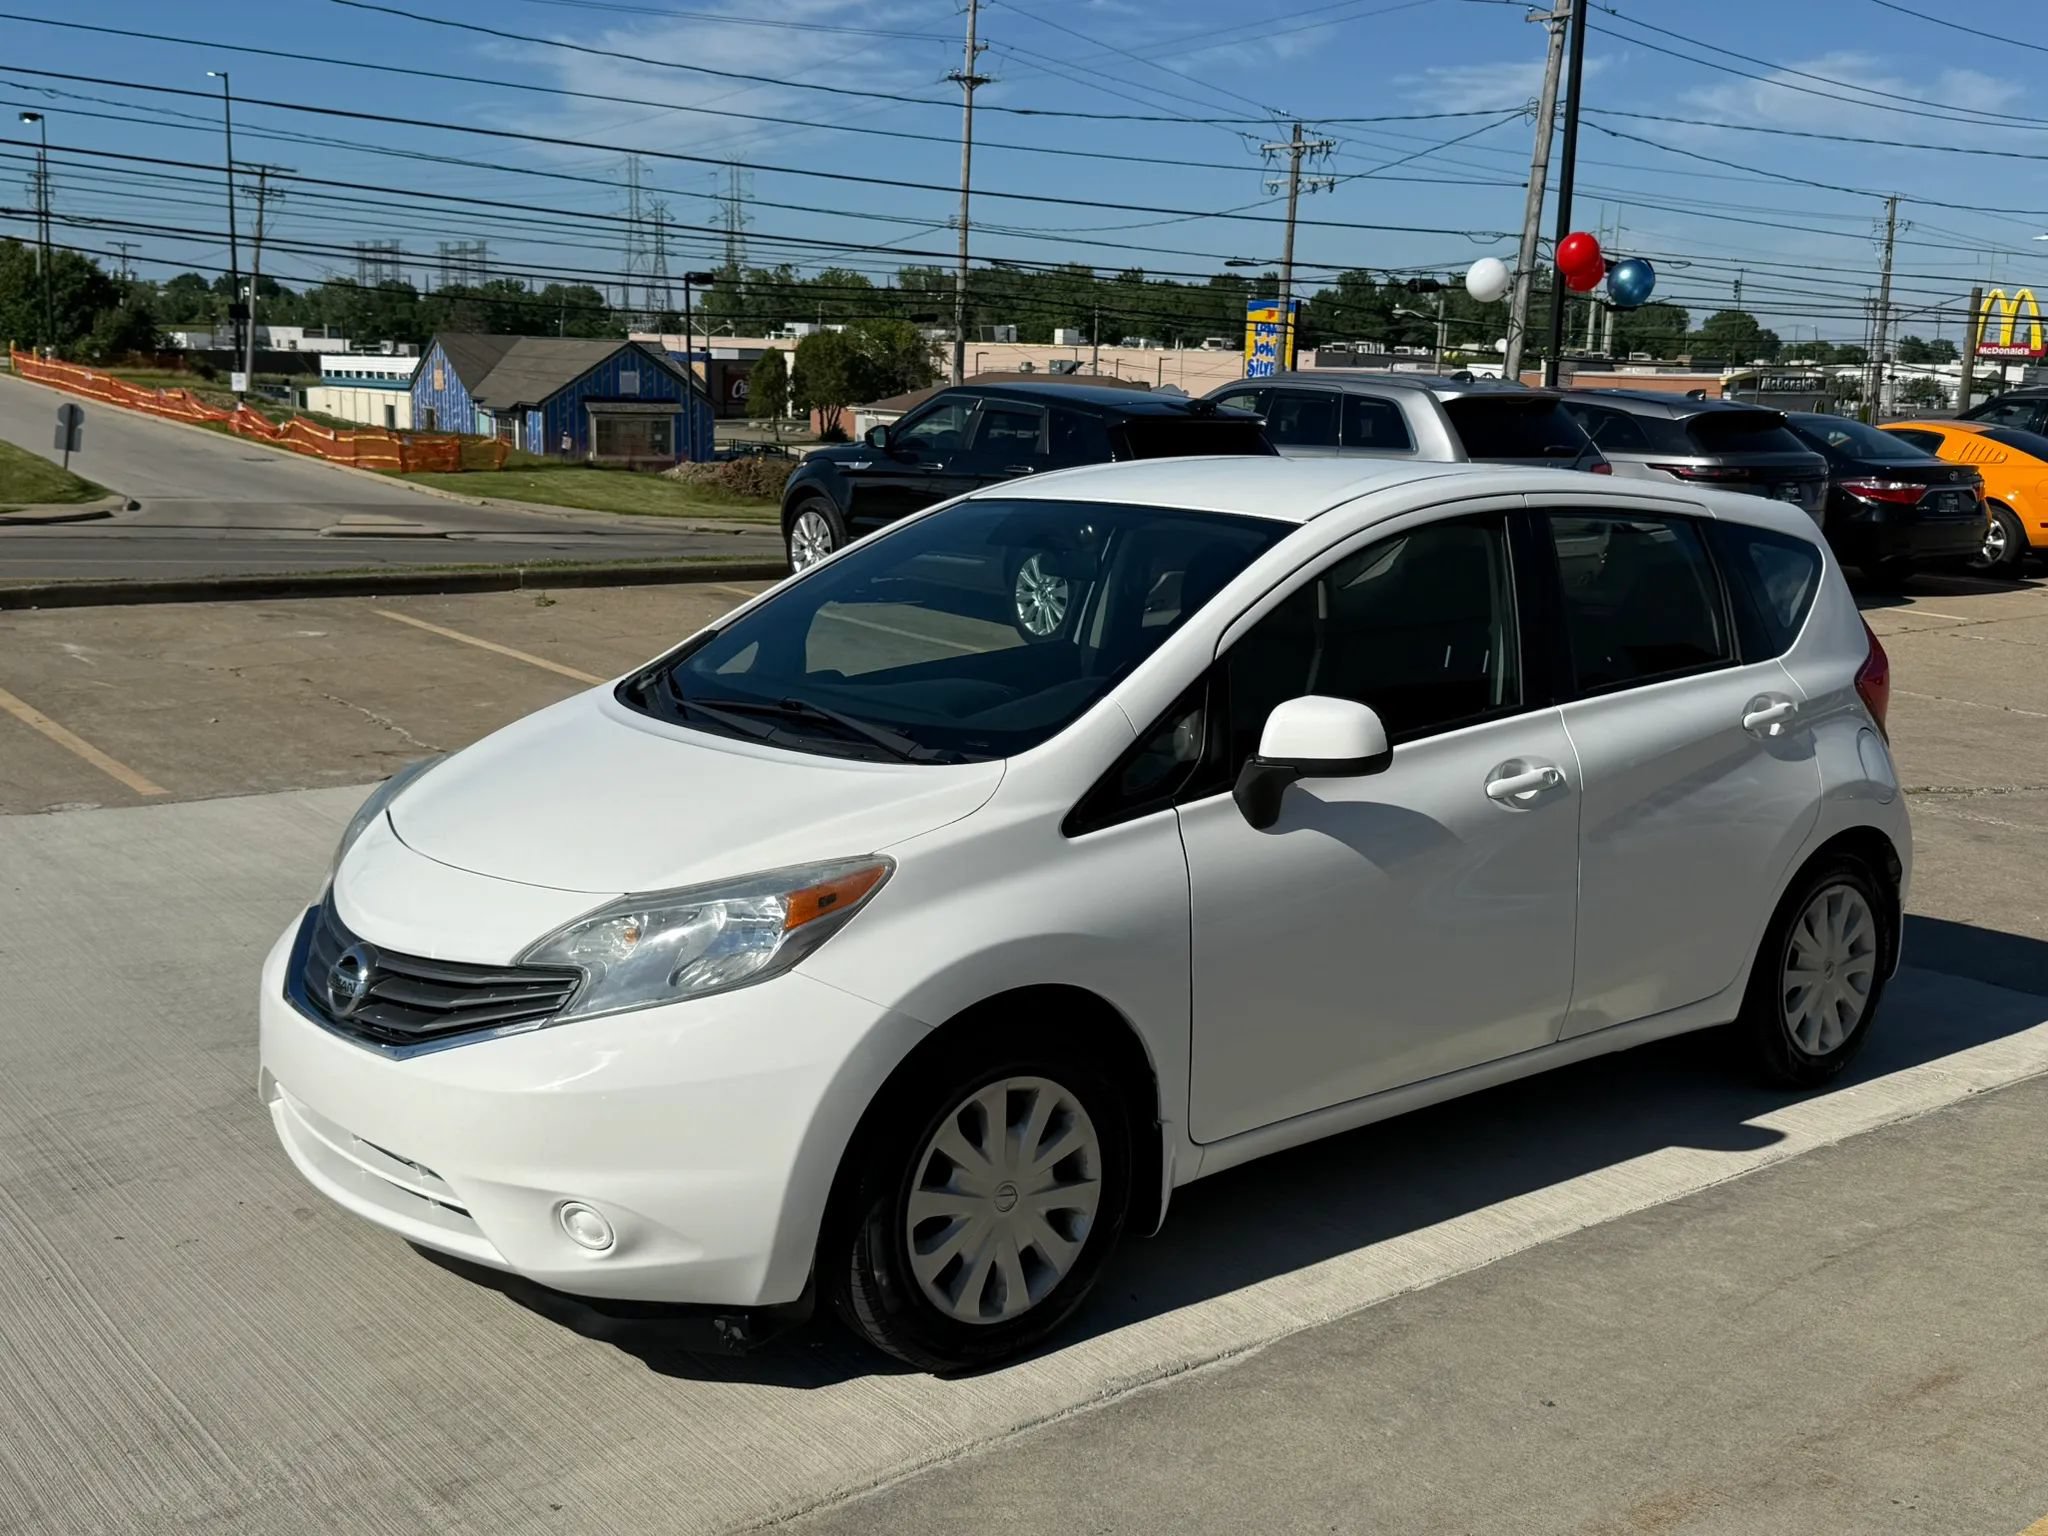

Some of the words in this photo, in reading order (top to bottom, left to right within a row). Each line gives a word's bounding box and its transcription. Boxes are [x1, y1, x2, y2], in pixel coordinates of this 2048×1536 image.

[1252, 340, 1275, 357] JOH
[1979, 346, 2030, 355] McDonald's
[1761, 377, 1817, 390] McDonald's
